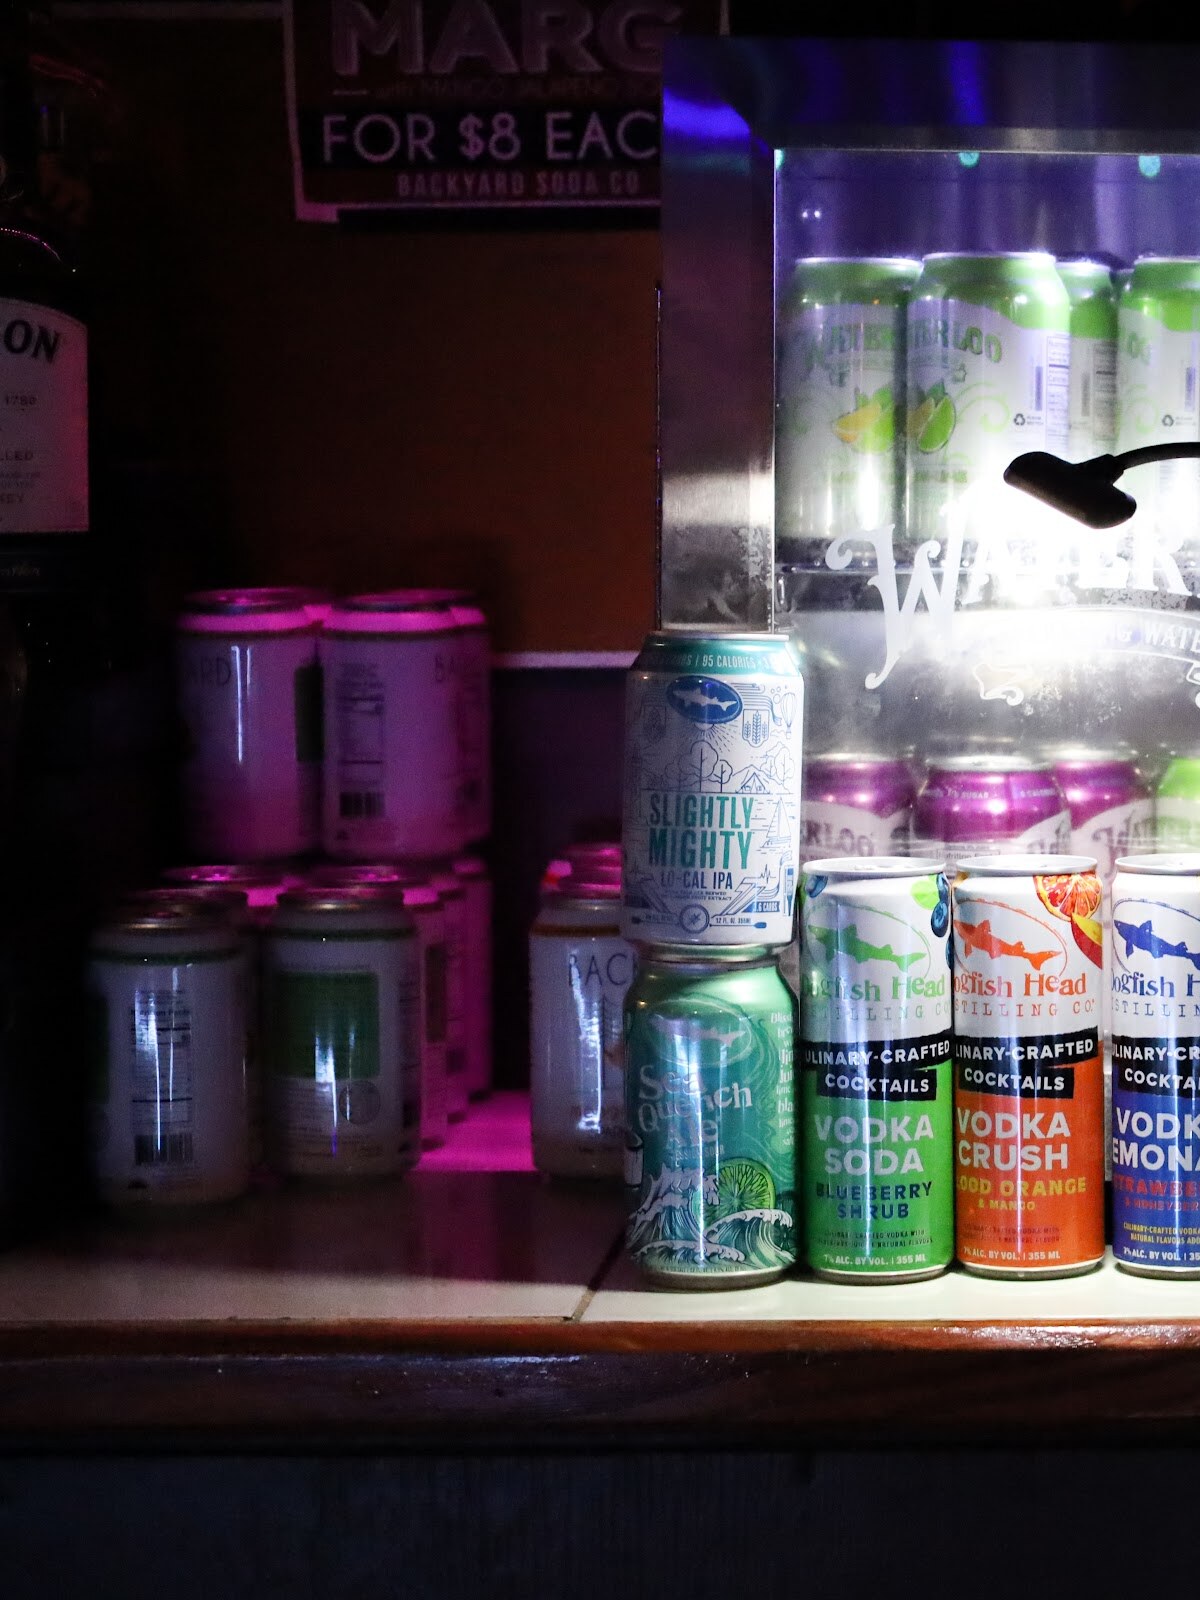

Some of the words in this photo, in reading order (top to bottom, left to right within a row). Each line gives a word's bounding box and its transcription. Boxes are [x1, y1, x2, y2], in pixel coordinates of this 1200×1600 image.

[322, 112, 436, 163] FOR
[457, 112, 522, 161] $8
[396, 171, 525, 197] BACKYARD
[536, 171, 599, 195] SODA
[608, 172, 641, 194] CO
[702, 654, 714, 667] 95
[717, 655, 756, 669] CALORIES
[649, 793, 755, 829] SLIGHTLY
[648, 827, 754, 869] MIGHTY
[660, 870, 708, 890] LO-CAL
[713, 871, 733, 890] IPA
[568, 952, 634, 987] BAC
[892, 974, 946, 1000] Head
[1024, 972, 1086, 997] Head
[638, 1065, 704, 1100] Sea
[824, 1073, 930, 1094] COCKTAILS
[964, 1067, 1065, 1091] COCKTAILS
[638, 1082, 753, 1133] Quench
[814, 1114, 934, 1144] VODKA
[957, 1107, 1071, 1139] VODKA
[824, 1147, 925, 1176] SODA
[958, 1139, 1069, 1172] CRUSH
[816, 1181, 934, 1201] BLUEBERRY
[1000, 1176, 1087, 1197] ORANGE
[837, 1203, 910, 1221] SHRUB
[1123, 1221, 1177, 1235] CULINARY-CRAFTED
[1130, 1233, 1155, 1244] NATURAL
[1156, 1234, 1185, 1245] FLAVORS
[835, 1255, 853, 1265] ALC.
[854, 1256, 866, 1265] BY
[869, 1256, 888, 1265] VOL.
[896, 1255, 914, 1265] 355
[915, 1253, 926, 1263] ML
[972, 1248, 987, 1258] ALC.
[989, 1250, 999, 1259] BY
[1000, 1251, 1020, 1261] VOL.
[1028, 1251, 1046, 1260] 355
[1048, 1251, 1060, 1260] ML
[1131, 1248, 1147, 1259] ALC.
[1149, 1251, 1159, 1260] BY
[1161, 1251, 1181, 1261] VOL.
